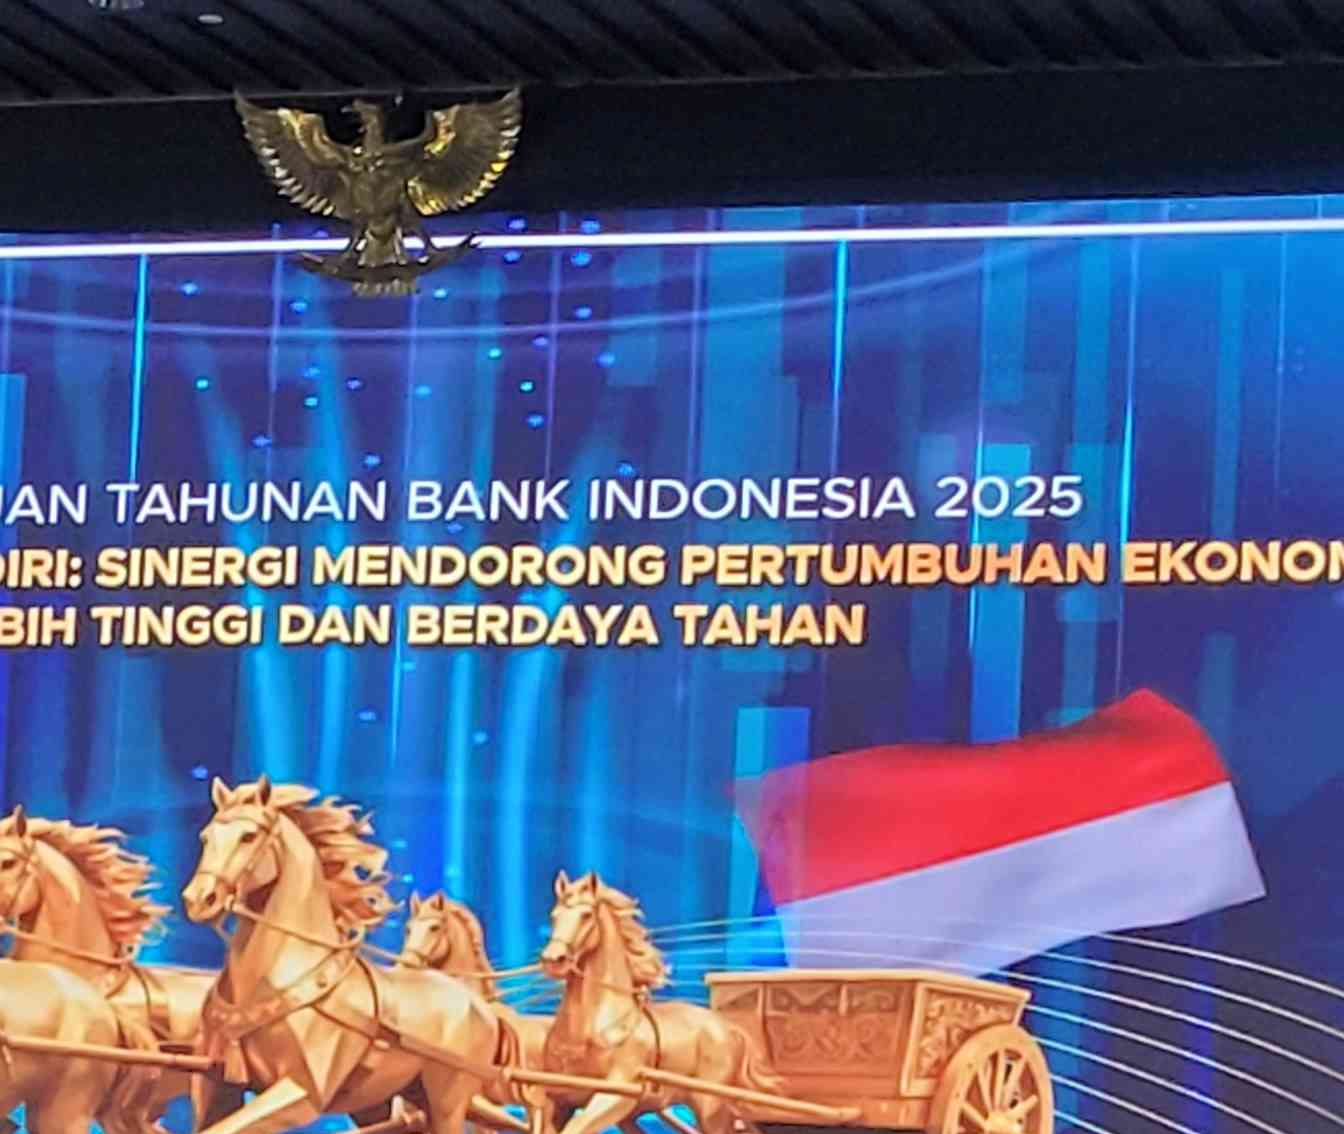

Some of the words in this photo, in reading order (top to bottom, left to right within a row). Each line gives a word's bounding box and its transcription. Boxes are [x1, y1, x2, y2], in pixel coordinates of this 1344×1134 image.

[106, 481, 386, 524] TAHUNAN
[406, 480, 570, 521] BANK
[589, 476, 916, 519] INDONESIA
[936, 474, 1084, 517] 2025
[94, 545, 297, 588] SINERGI
[313, 543, 667, 587] MENDORONG
[681, 541, 1106, 586] PERTUMBUHAN
[91, 606, 263, 648] TINGGI
[278, 605, 391, 647] DAN
[406, 604, 660, 646] BERDAYA
[674, 603, 867, 646] TAHAN
